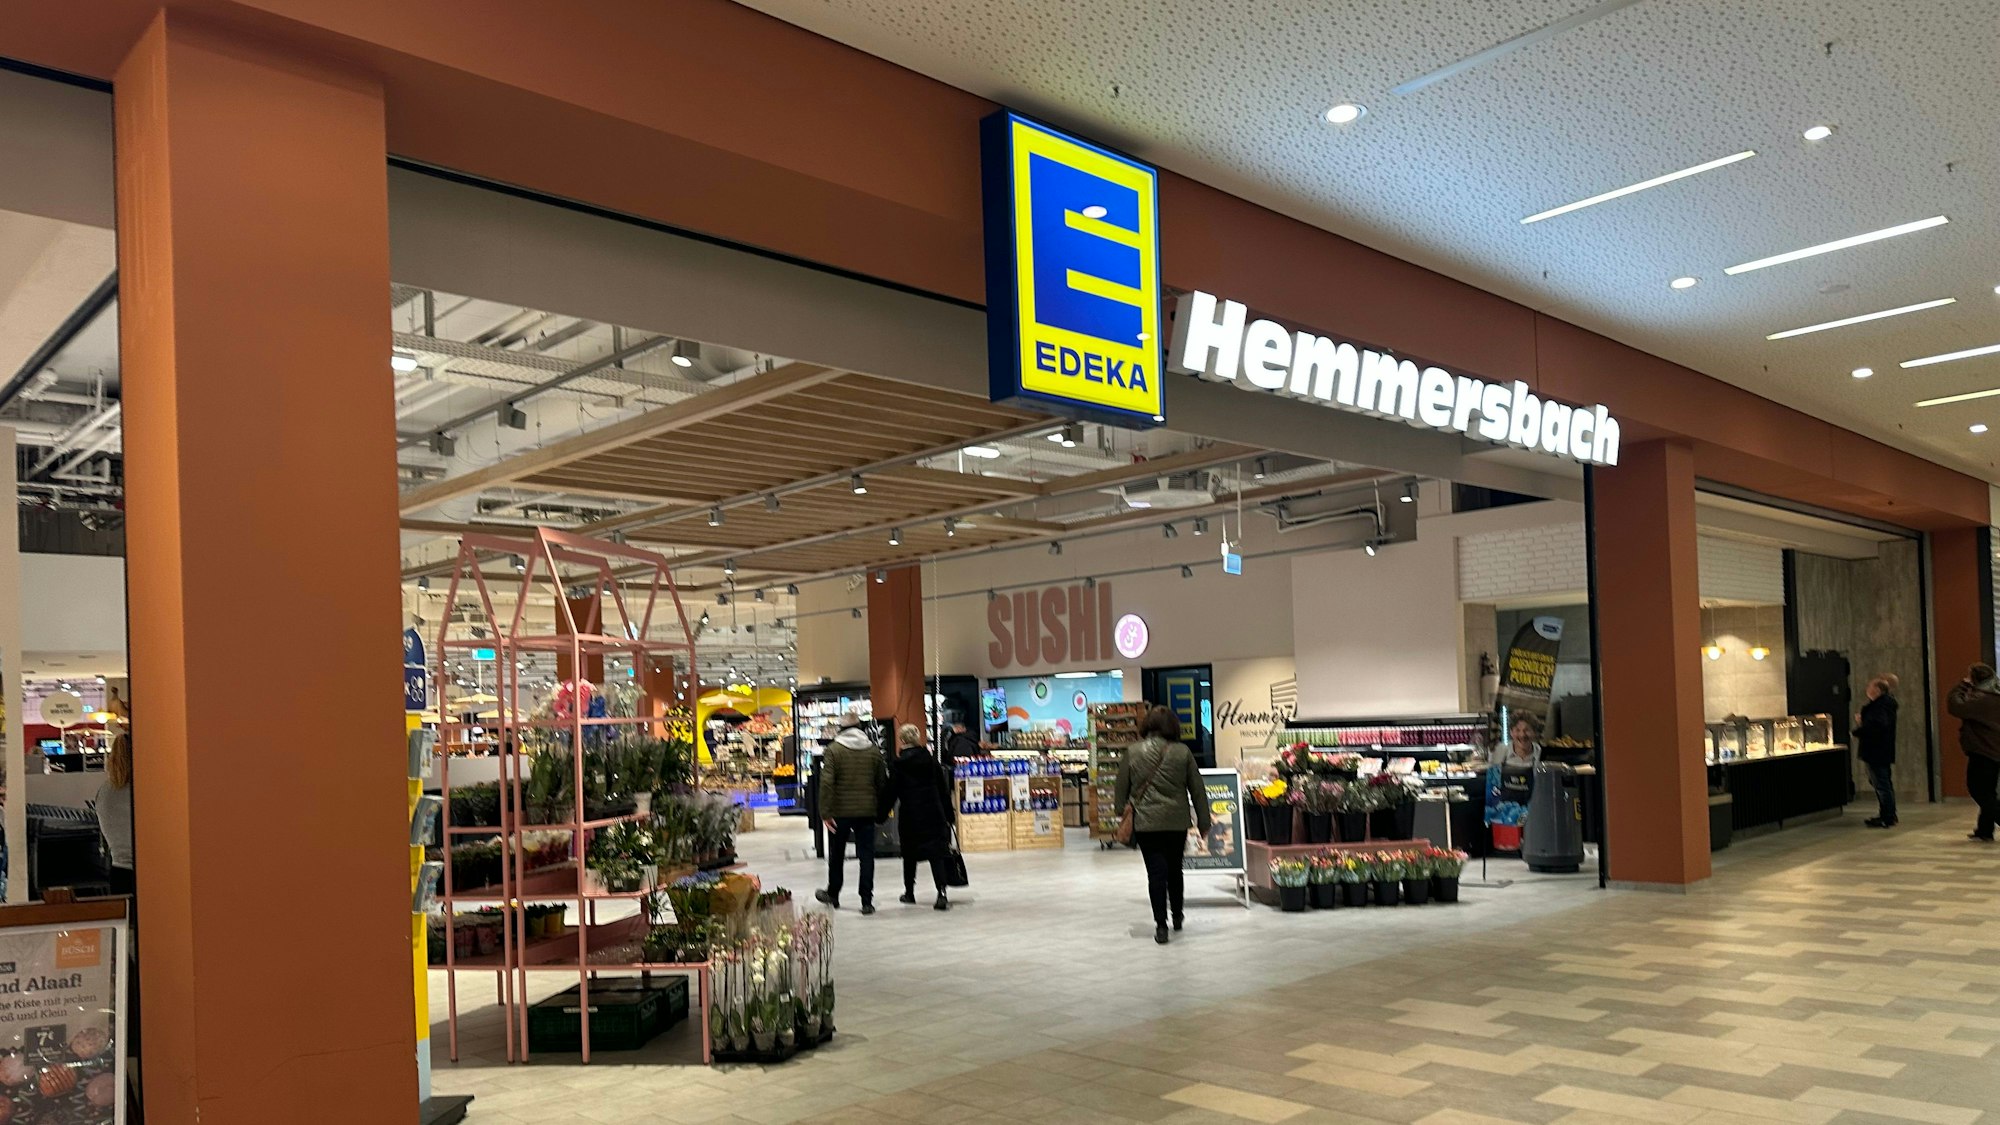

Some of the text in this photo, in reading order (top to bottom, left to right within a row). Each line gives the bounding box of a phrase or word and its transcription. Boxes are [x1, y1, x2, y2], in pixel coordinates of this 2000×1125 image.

[1035, 340, 1148, 393] EDEKA
[1182, 290, 1620, 466] Hemmersbach
[987, 582, 1113, 669] SUSHI
[0, 973, 82, 994] nd Alaaf!
[0, 1009, 67, 1022] oß und Klein
[14, 999, 41, 1009] Kiste
